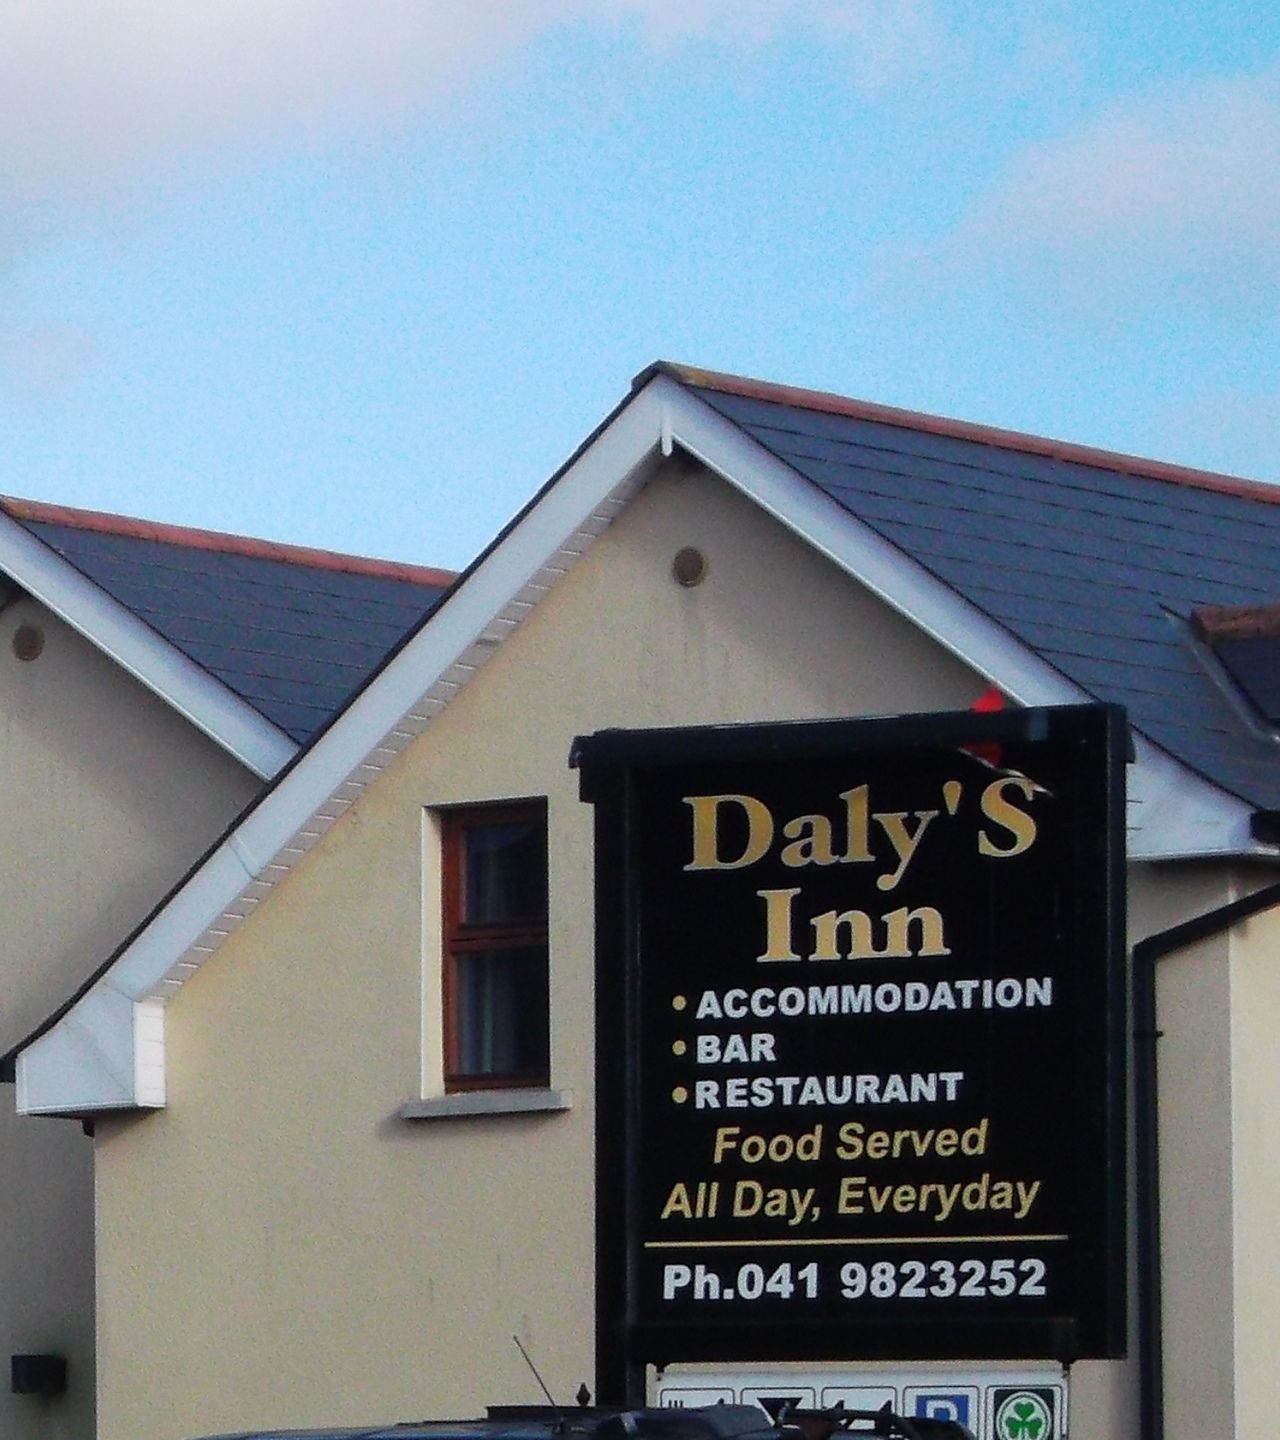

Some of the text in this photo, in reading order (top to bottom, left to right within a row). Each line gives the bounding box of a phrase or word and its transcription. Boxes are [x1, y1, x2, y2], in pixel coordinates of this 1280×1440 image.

[756, 887, 951, 963] Inn
[695, 977, 1053, 1020] ACCOMMODATION
[695, 1033, 777, 1065] BAR
[694, 1072, 964, 1110] RESTAURANT
[713, 1119, 989, 1164] Food Served
[660, 1173, 1040, 1226] All Day, Everyday
[663, 1258, 1047, 1300] Ph.041 9823252
